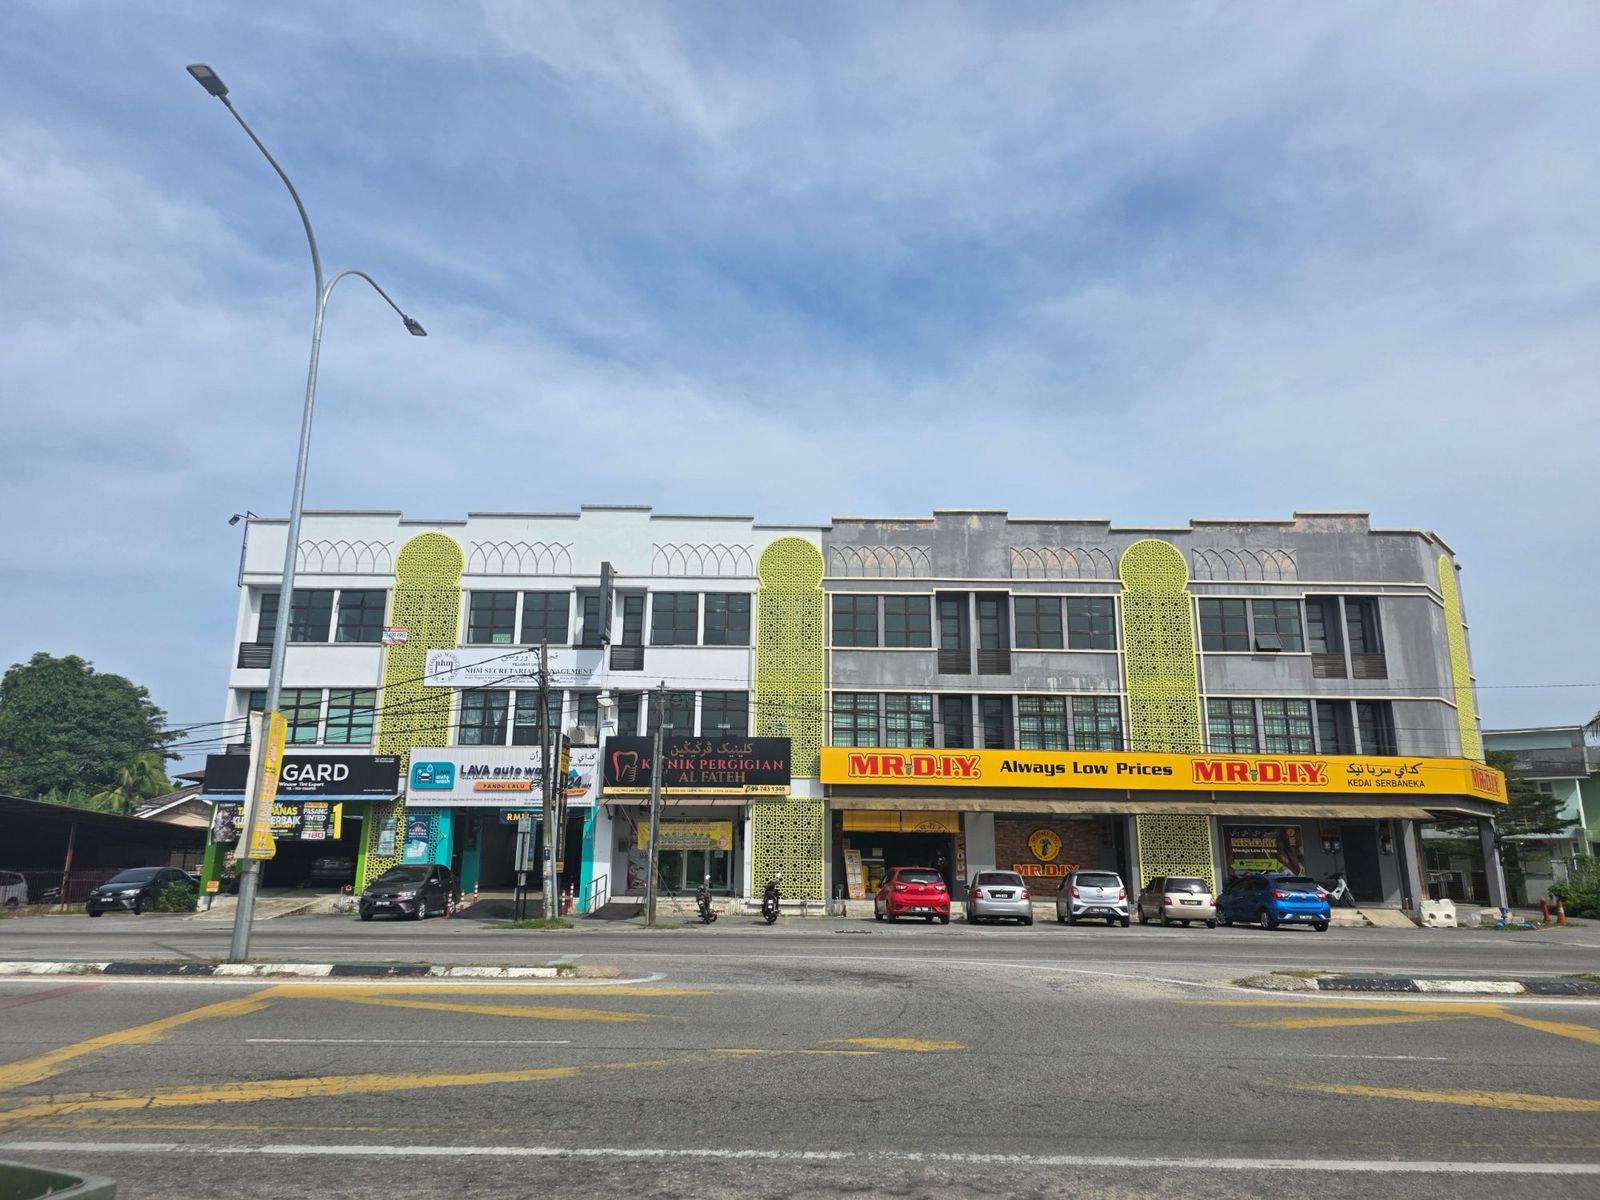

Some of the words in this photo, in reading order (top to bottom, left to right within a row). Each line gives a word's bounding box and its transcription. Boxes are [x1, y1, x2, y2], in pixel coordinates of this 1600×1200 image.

[460, 765, 490, 777] LAVA
[494, 764, 522, 776] auto
[641, 760, 695, 770] KNIK
[699, 759, 784, 770] PERGIGIAN
[1000, 760, 1066, 777] Always
[1073, 761, 1109, 775] Low
[1116, 763, 1173, 776] Prices
[678, 771, 696, 783] AL
[701, 771, 746, 783] FATEH
[1348, 779, 1372, 787] KEDAI
[1375, 779, 1426, 788] SERBANEKA
